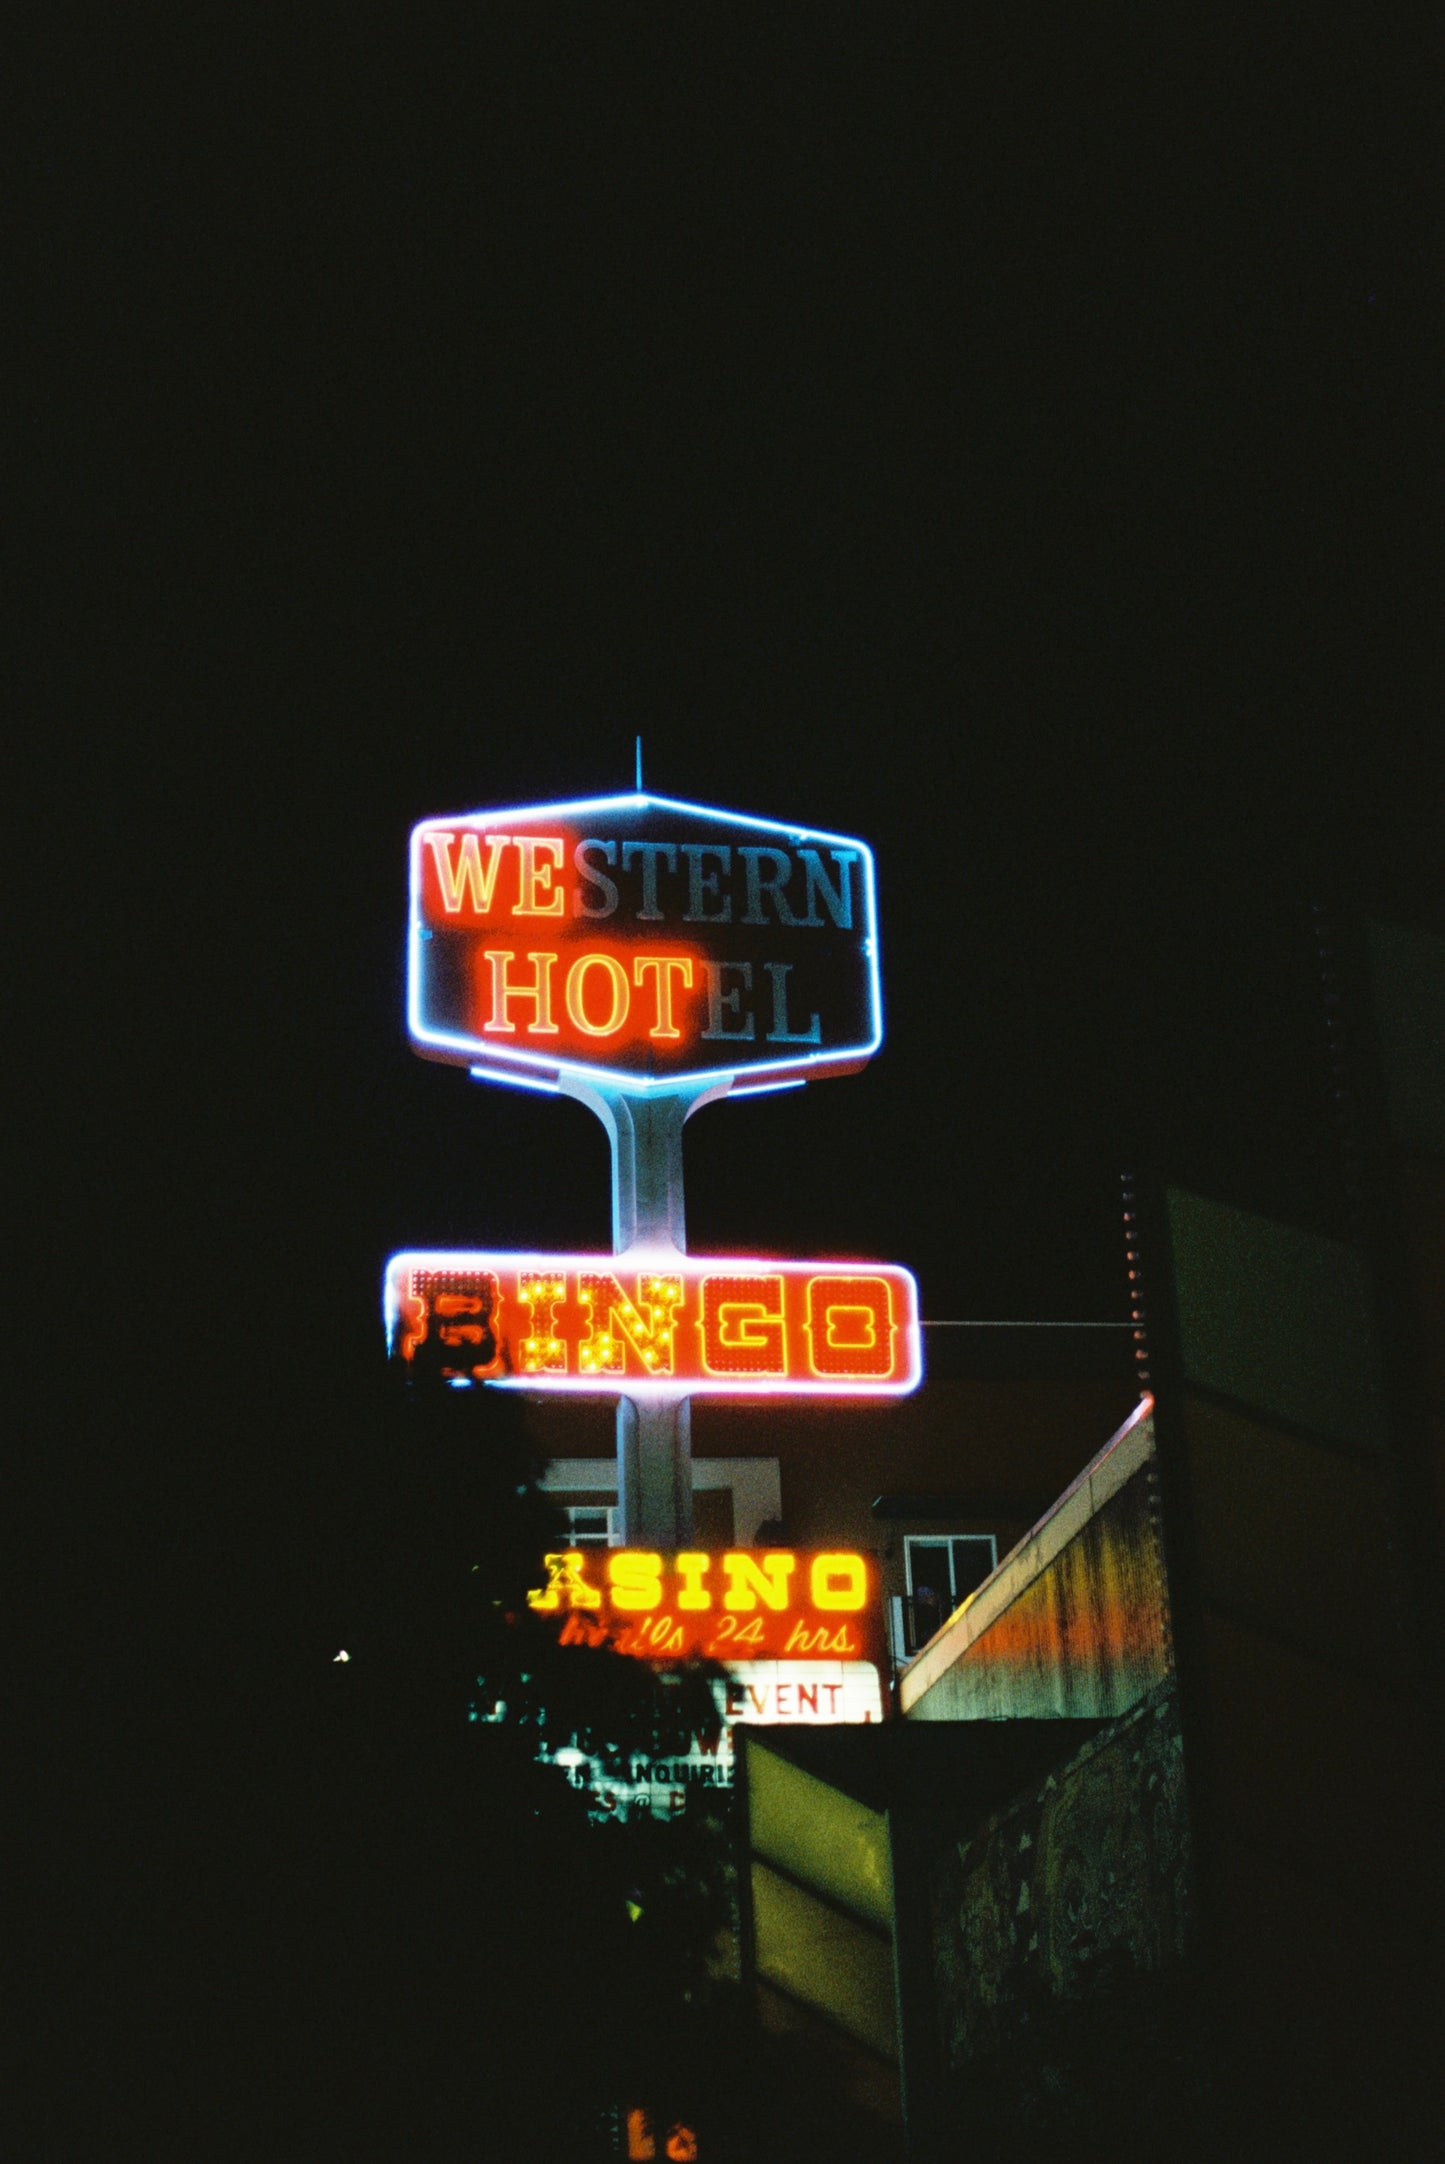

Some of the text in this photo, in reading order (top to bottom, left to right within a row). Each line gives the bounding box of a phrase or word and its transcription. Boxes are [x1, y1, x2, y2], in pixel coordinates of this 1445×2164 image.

[424, 831, 857, 929] WESTERN
[484, 950, 821, 1043] HOTEL
[406, 1268, 898, 1380] BINGO
[527, 1553, 867, 1610] ASINO
[709, 1615, 765, 1651] 24
